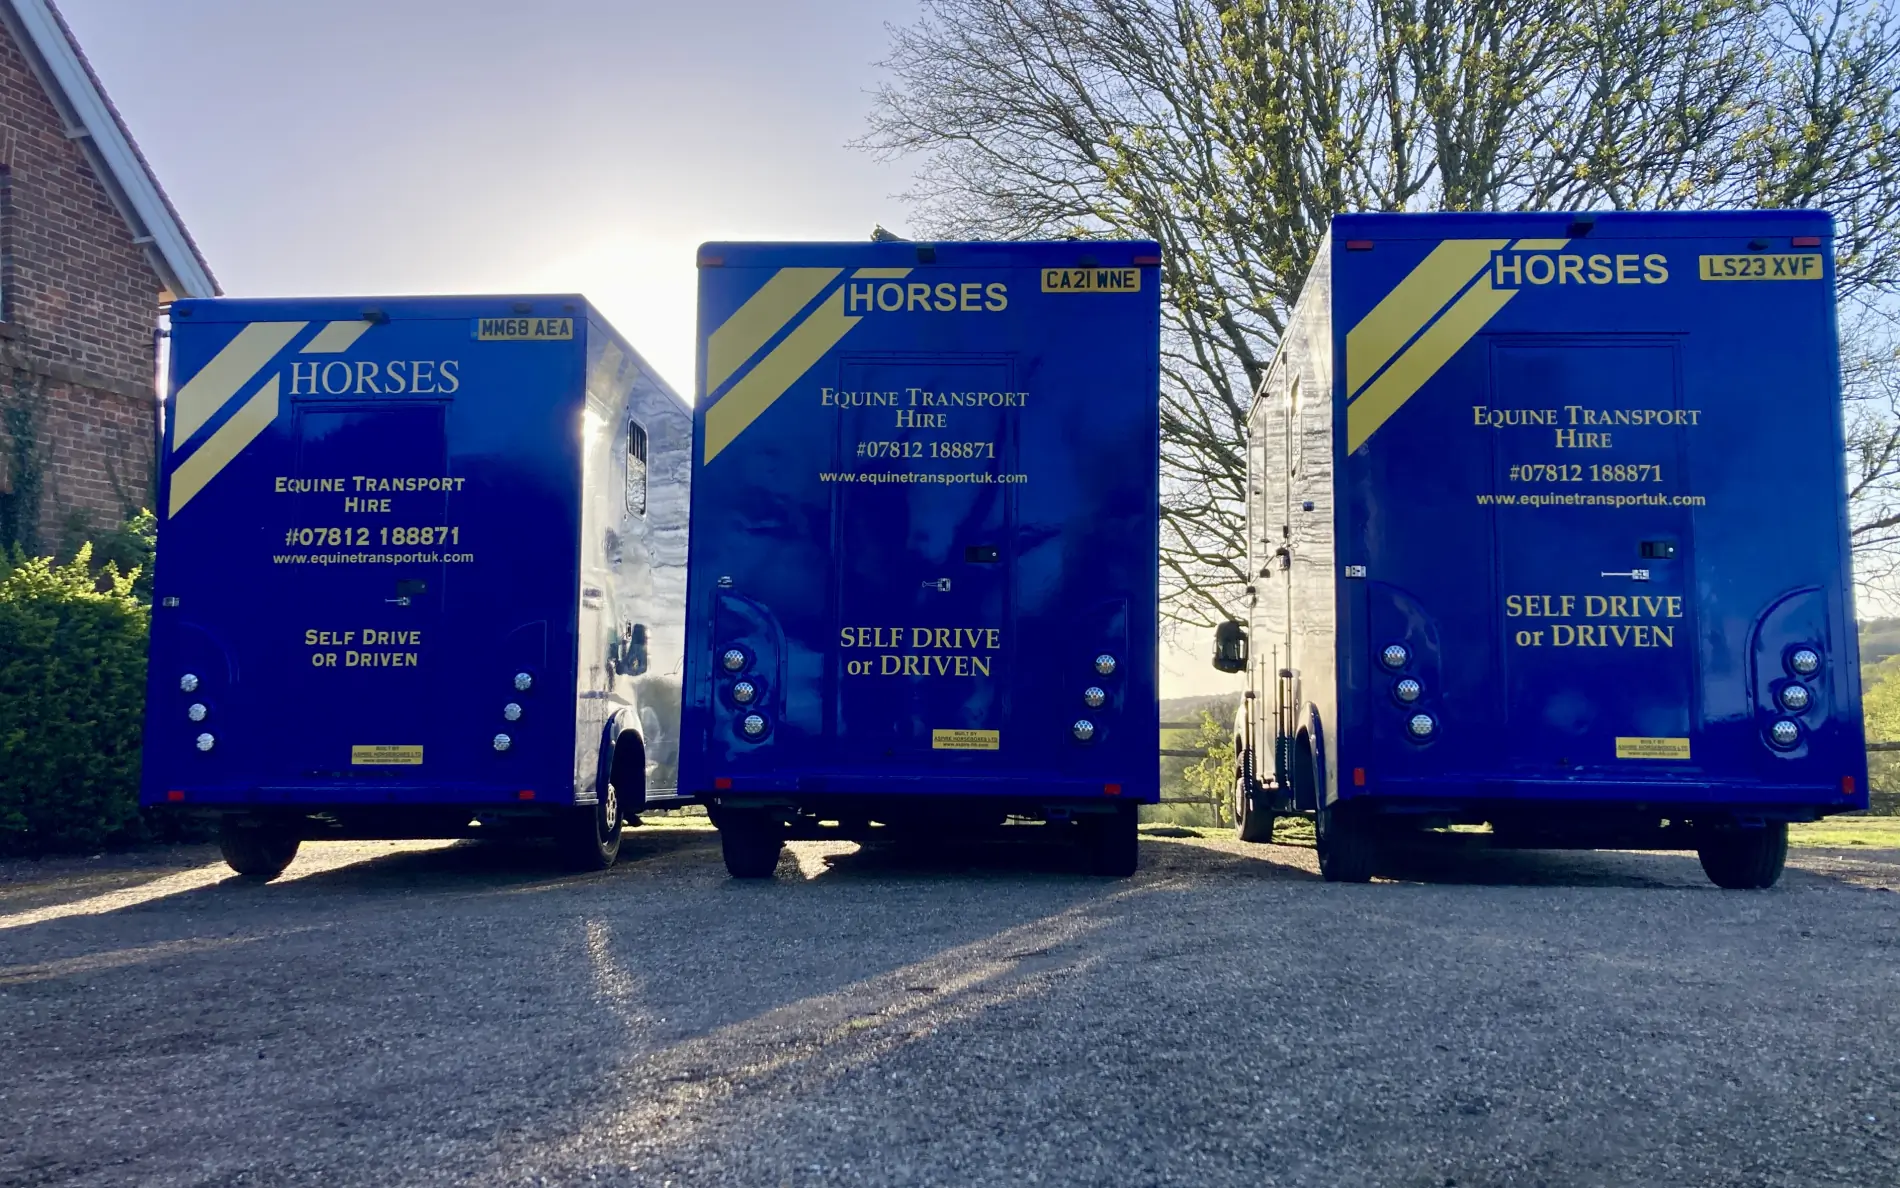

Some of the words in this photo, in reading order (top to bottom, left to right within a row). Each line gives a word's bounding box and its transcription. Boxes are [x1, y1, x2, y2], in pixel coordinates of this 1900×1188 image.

[1496, 254, 1668, 284] HORSES
[1710, 258, 1765, 276] LS23
[1773, 257, 1814, 276] XVF
[1046, 270, 1092, 289] CA21
[1097, 270, 1135, 289] WNE
[850, 283, 1007, 311] HORSES
[482, 320, 528, 336] MM68
[535, 320, 569, 335] AEA
[289, 360, 459, 394] HORSES
[820, 388, 899, 409] EQUINE
[906, 388, 1029, 408] TRANSPORT
[896, 410, 946, 427] HIRE
[1473, 405, 1558, 428] EQUINE
[1564, 406, 1701, 425] TRANSPORT
[1555, 429, 1612, 448] HIRE
[857, 442, 922, 457] #07812
[930, 442, 995, 458] 188871
[820, 471, 1027, 486] www.equinetransportuk.com
[1510, 464, 1582, 481] #07812
[1589, 464, 1663, 481] 188871
[275, 477, 345, 493] EQUINE
[353, 476, 465, 491] TRANSPORT
[345, 497, 391, 512] HIRE
[1476, 492, 1706, 508] www.equinetransportuk.com
[285, 527, 369, 546] #07812
[380, 527, 458, 545] 188871
[273, 551, 473, 566] www.equinetransportuk.com
[1507, 595, 1575, 616] SELF
[1584, 596, 1682, 617] DRIVE
[305, 629, 355, 645] SELF
[363, 629, 420, 644] DRIVE
[841, 627, 903, 647] SELF
[911, 628, 1001, 649] DRIVE
[1516, 631, 1544, 646] or
[1551, 625, 1674, 647] DRIVEN
[346, 651, 417, 666] DRIVEN
[848, 661, 872, 675] or
[881, 655, 991, 676] DRIVEN
